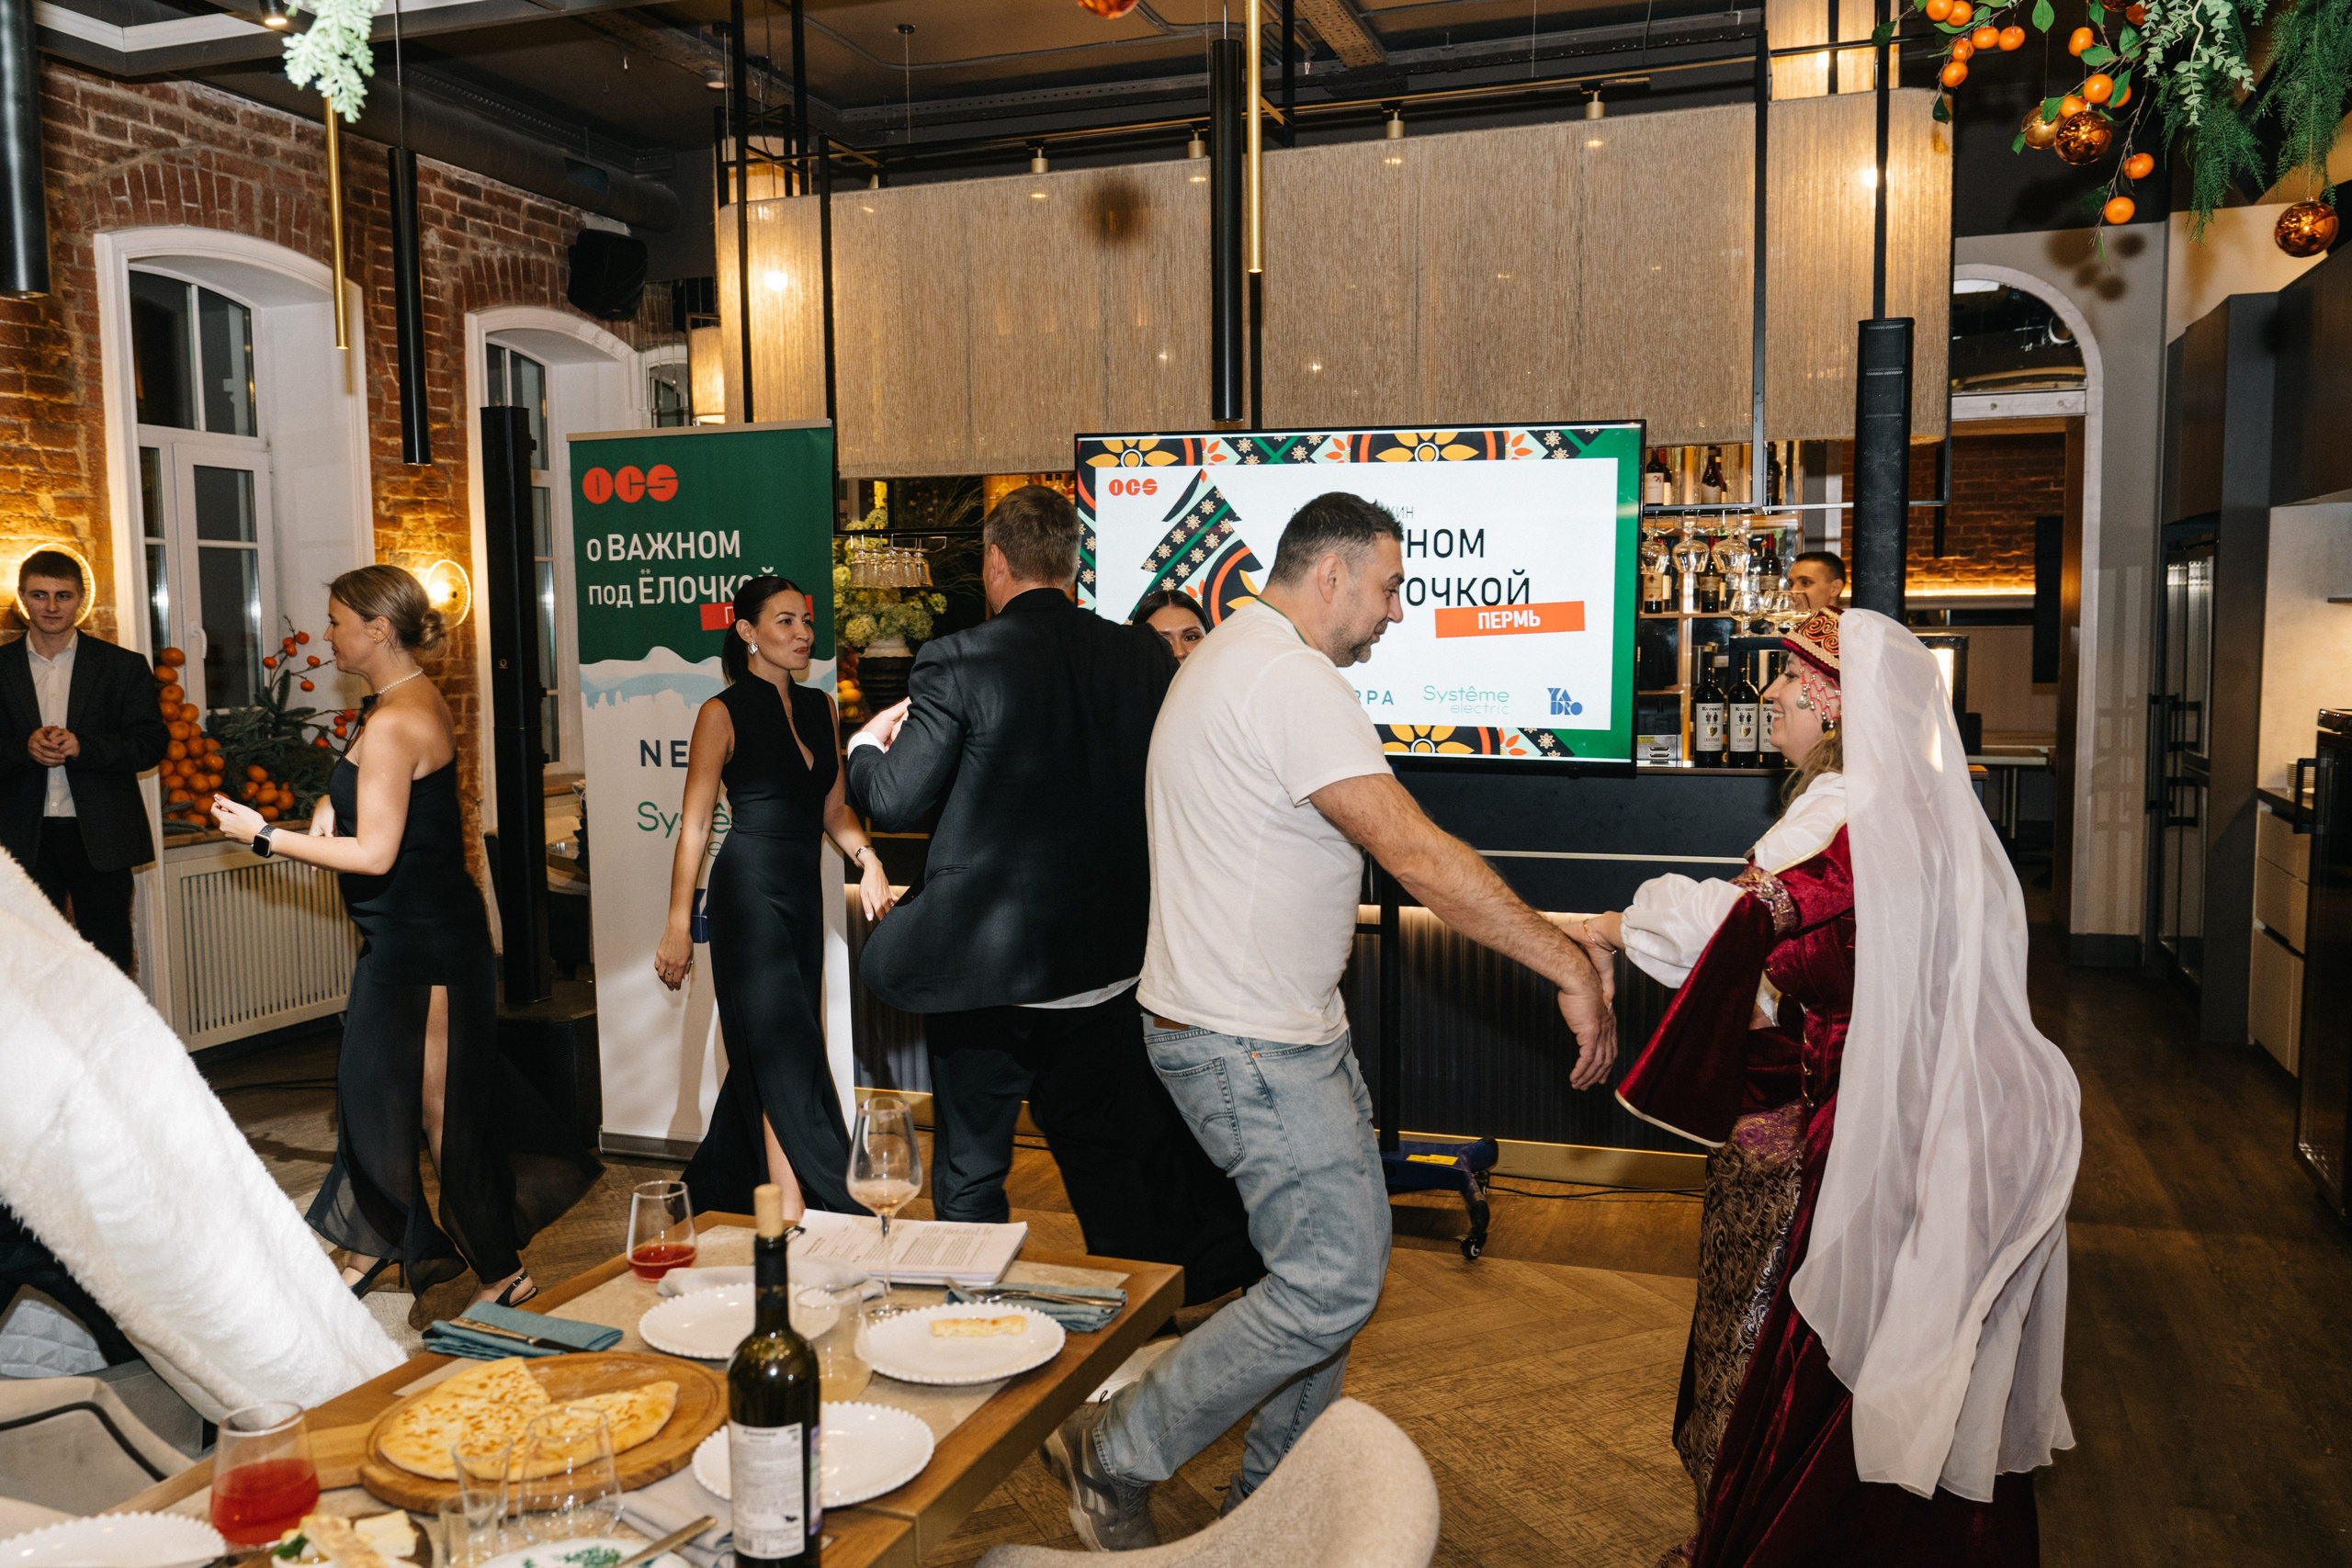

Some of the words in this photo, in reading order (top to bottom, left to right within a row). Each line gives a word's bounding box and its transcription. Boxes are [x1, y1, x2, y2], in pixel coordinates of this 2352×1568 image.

[582, 464, 678, 504] OCS
[1109, 479, 1158, 496] OCS
[587, 538, 602, 561] о
[607, 530, 741, 561] ВАЖНОМ
[1407, 528, 1485, 558] НОМ
[588, 584, 633, 608] под
[639, 567, 778, 605] ЁЛОЧК
[1406, 569, 1530, 606] ОЧКОЙ
[1477, 609, 1541, 630] ПЕРМЬ
[1423, 684, 1510, 704] Systême
[1450, 704, 1510, 715] electric
